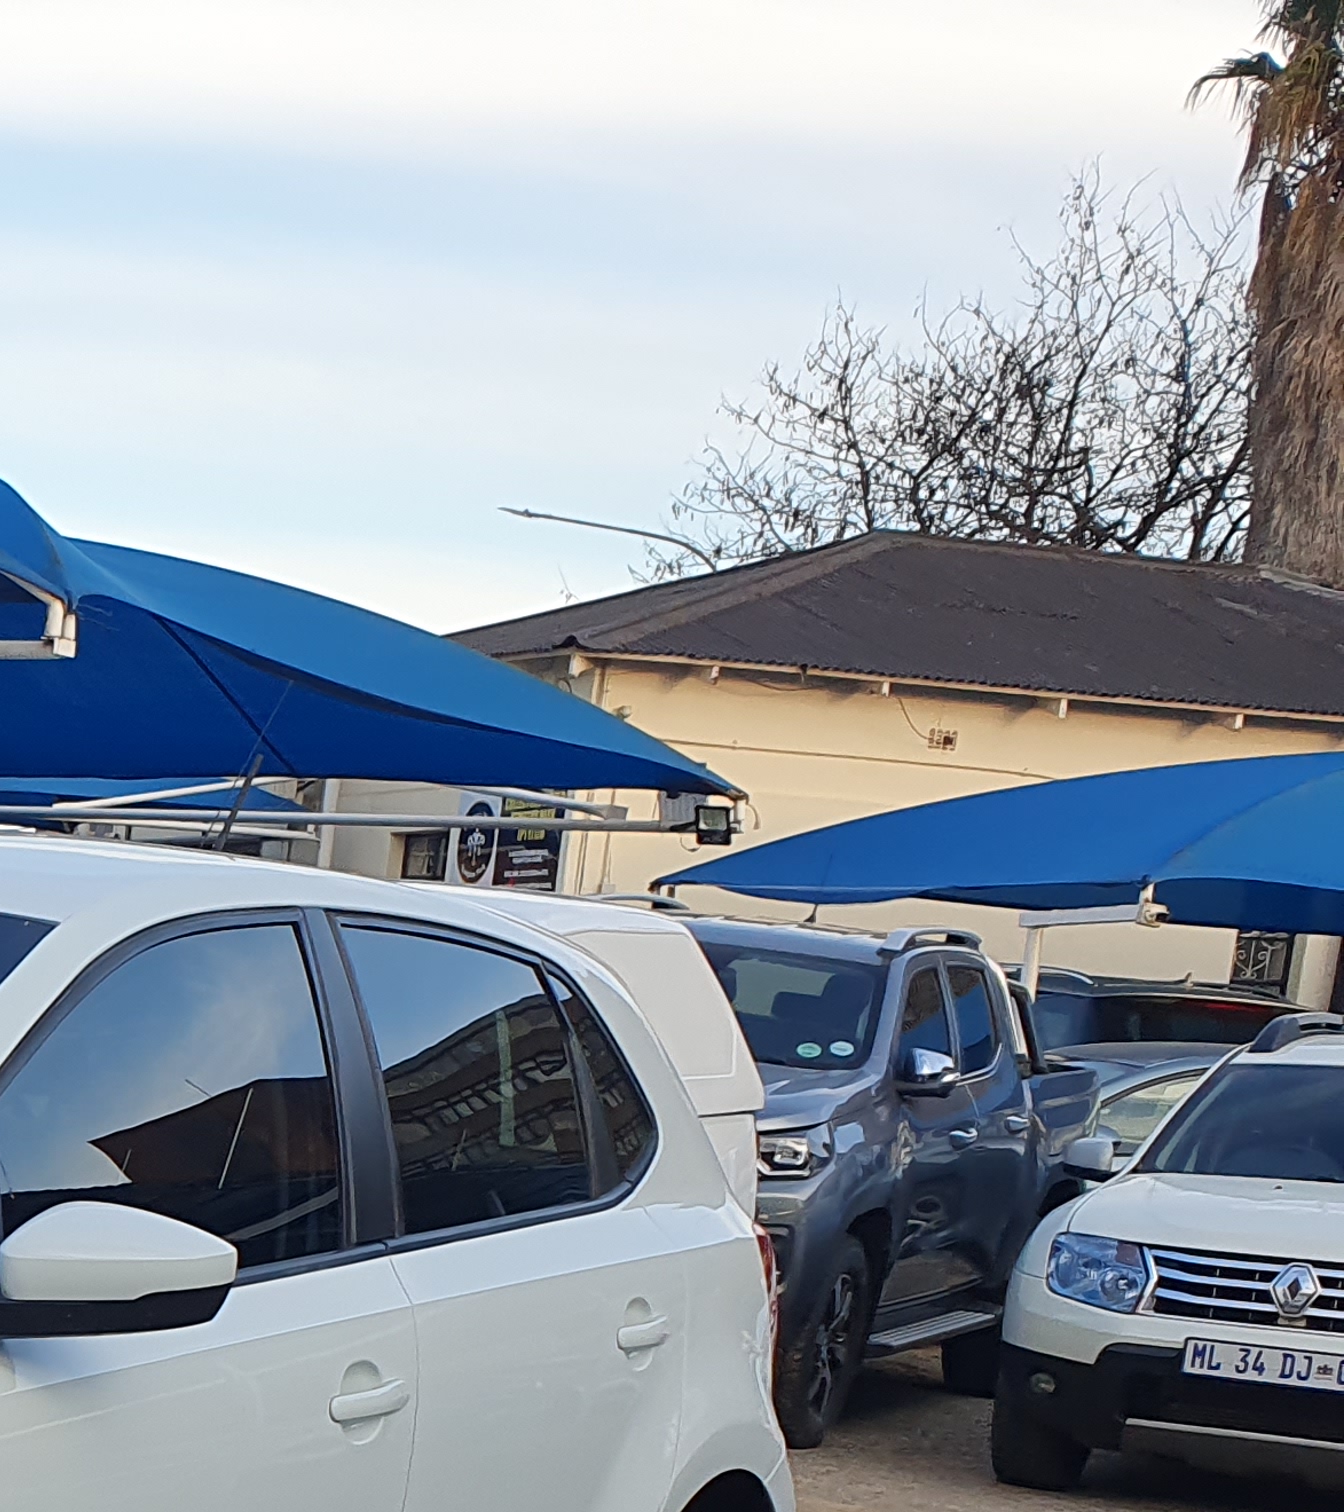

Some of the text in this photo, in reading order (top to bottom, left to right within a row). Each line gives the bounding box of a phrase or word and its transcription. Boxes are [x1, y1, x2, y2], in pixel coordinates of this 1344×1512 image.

[1190, 1342, 1221, 1371] ML
[1234, 1348, 1265, 1376] 34
[1278, 1352, 1312, 1381] DJ
